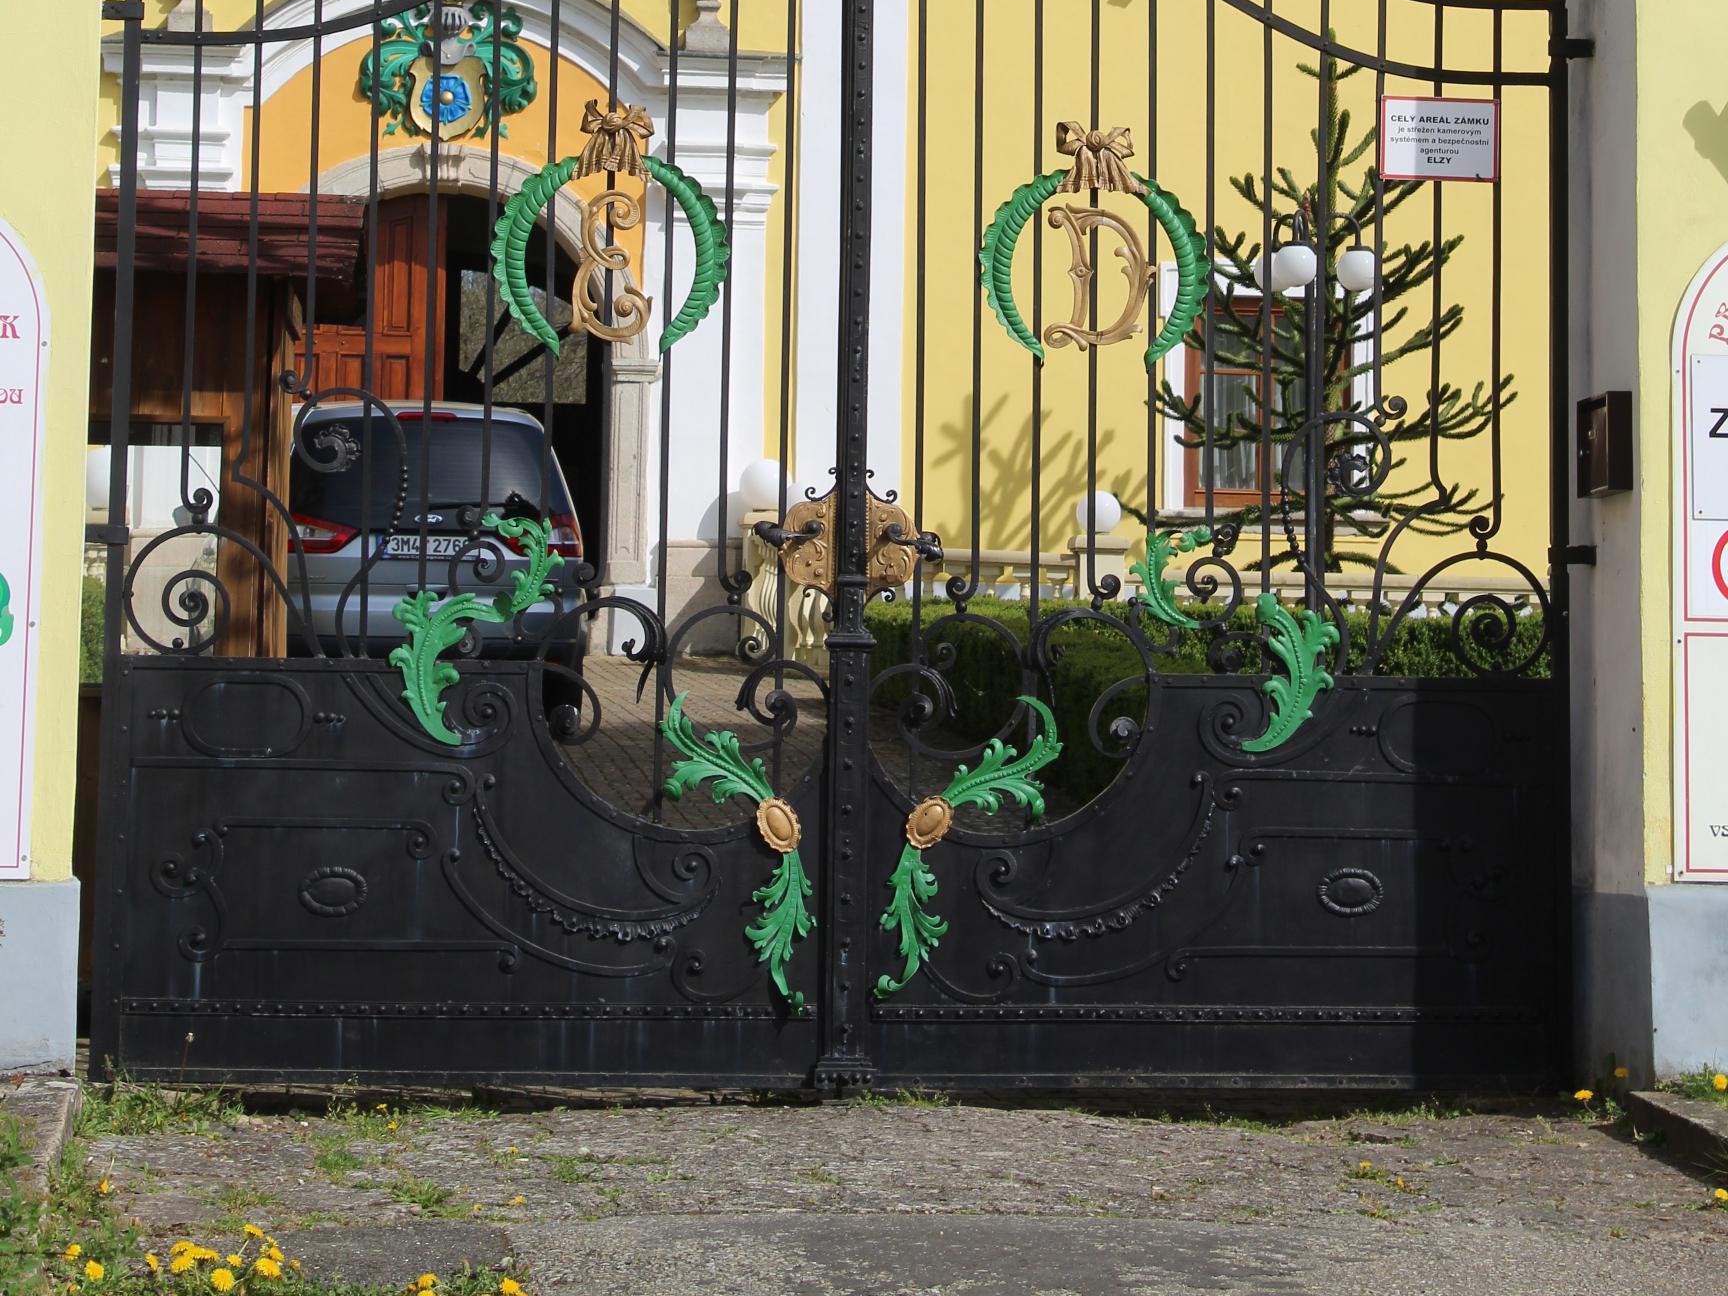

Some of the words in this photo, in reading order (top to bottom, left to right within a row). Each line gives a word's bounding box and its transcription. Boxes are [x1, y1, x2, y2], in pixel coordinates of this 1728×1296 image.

[1390, 114, 1416, 123] CELÝ
[1418, 115, 1451, 124] AREÁL
[1454, 116, 1490, 125] ZÁMKU
[1397, 126, 1405, 134] je
[1437, 126, 1482, 136] kamerovým
[1419, 147, 1460, 155] agenturou
[1427, 156, 1452, 164] ELZY
